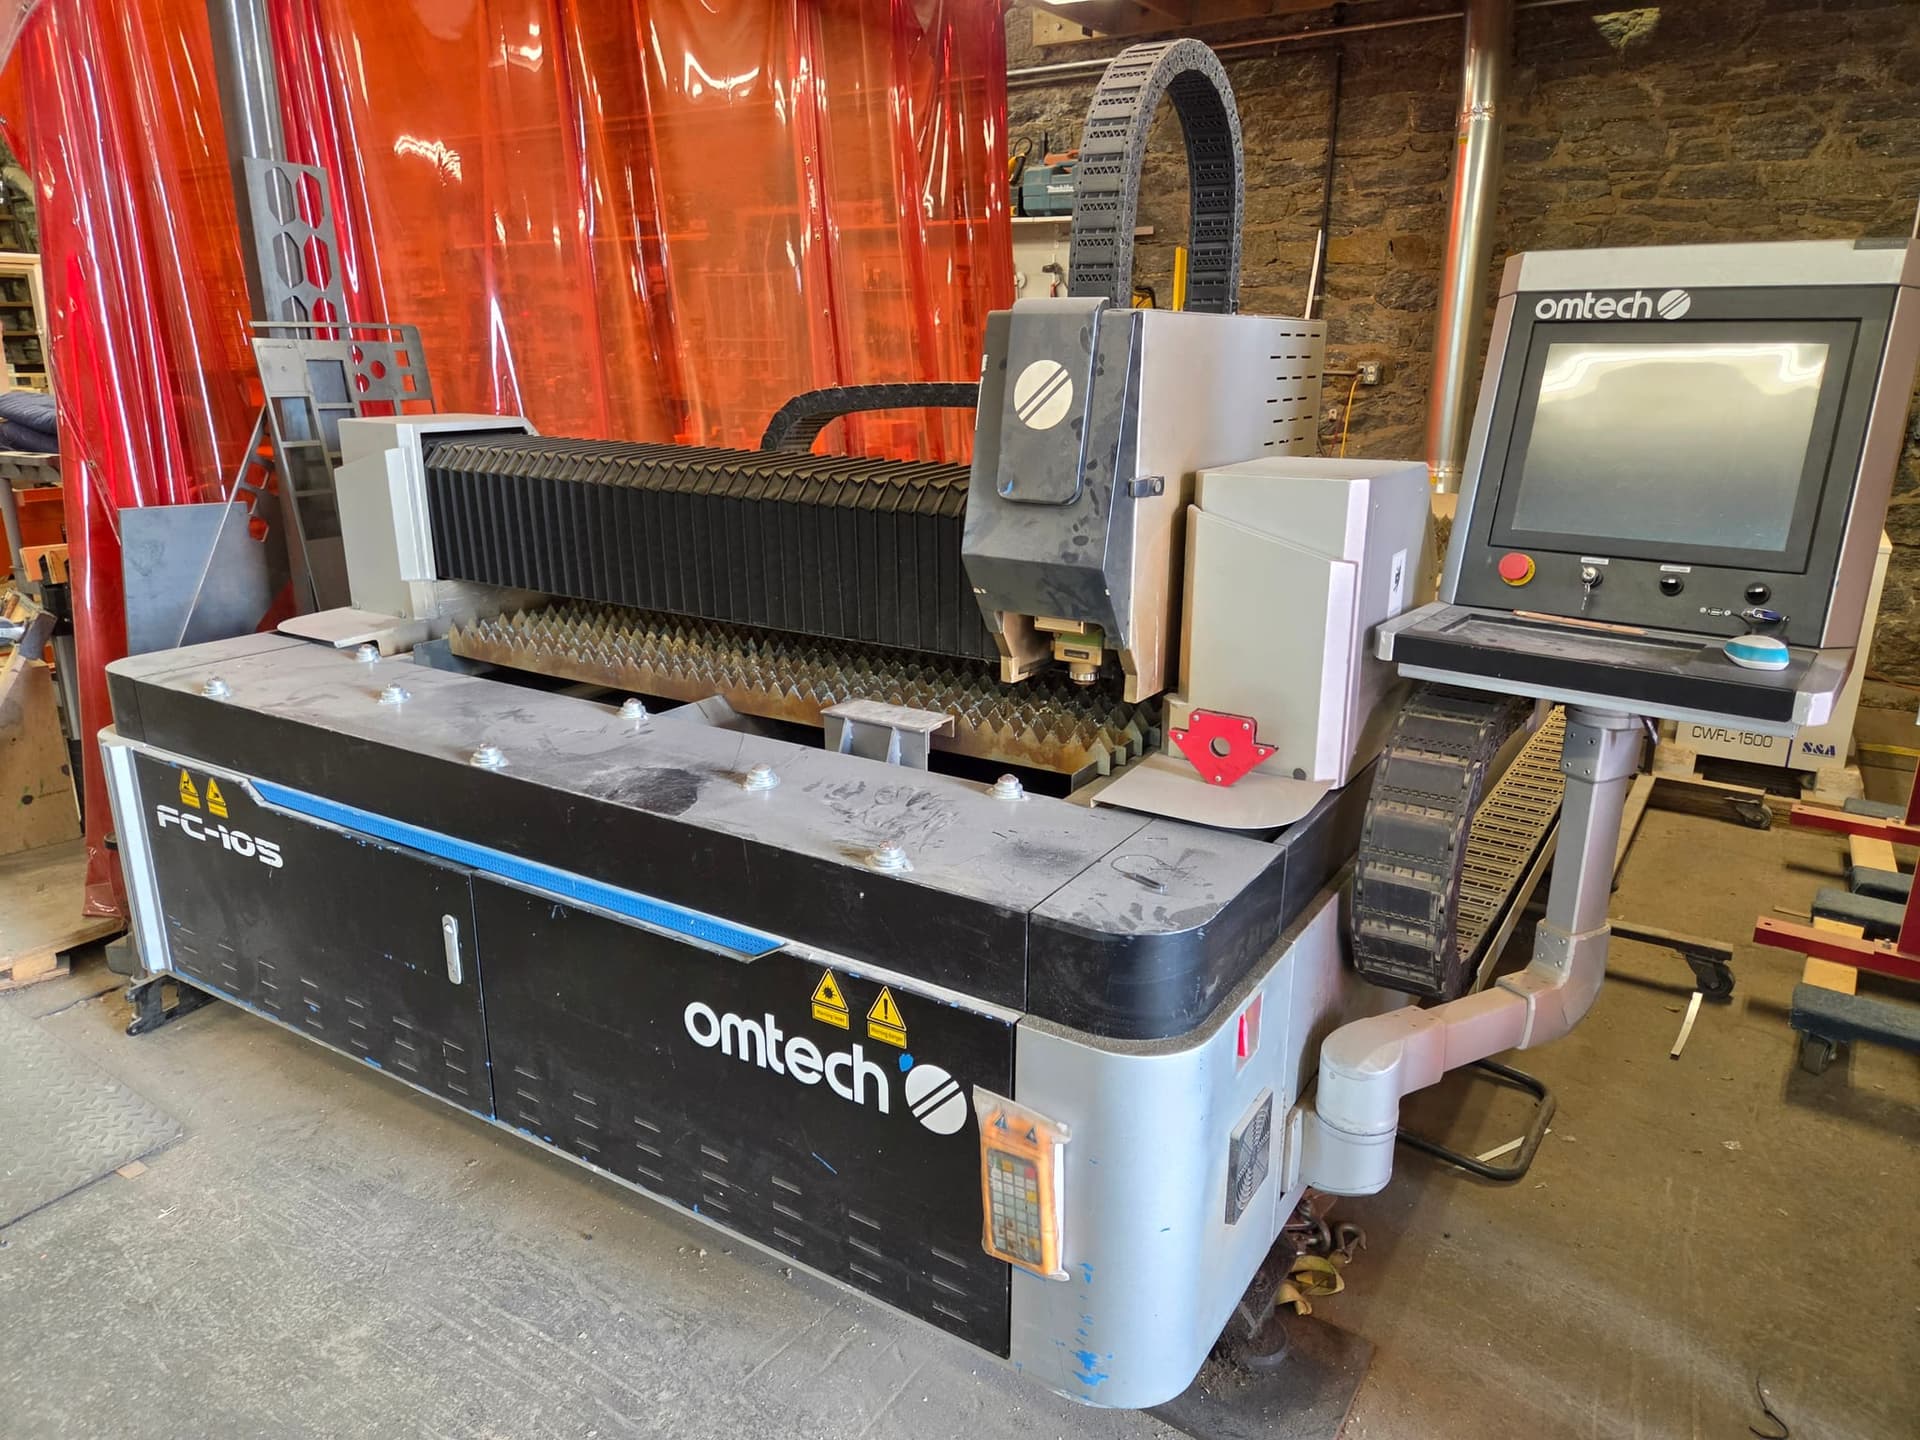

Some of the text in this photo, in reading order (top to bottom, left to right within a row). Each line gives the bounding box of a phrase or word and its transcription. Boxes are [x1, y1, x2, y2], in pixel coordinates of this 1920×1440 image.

[1535, 290, 1653, 320] omtech
[1691, 725, 1774, 749] CWFL-1500
[1801, 741, 1837, 757] S&A
[156, 804, 284, 869] FC-105
[684, 1001, 890, 1115] omtech
